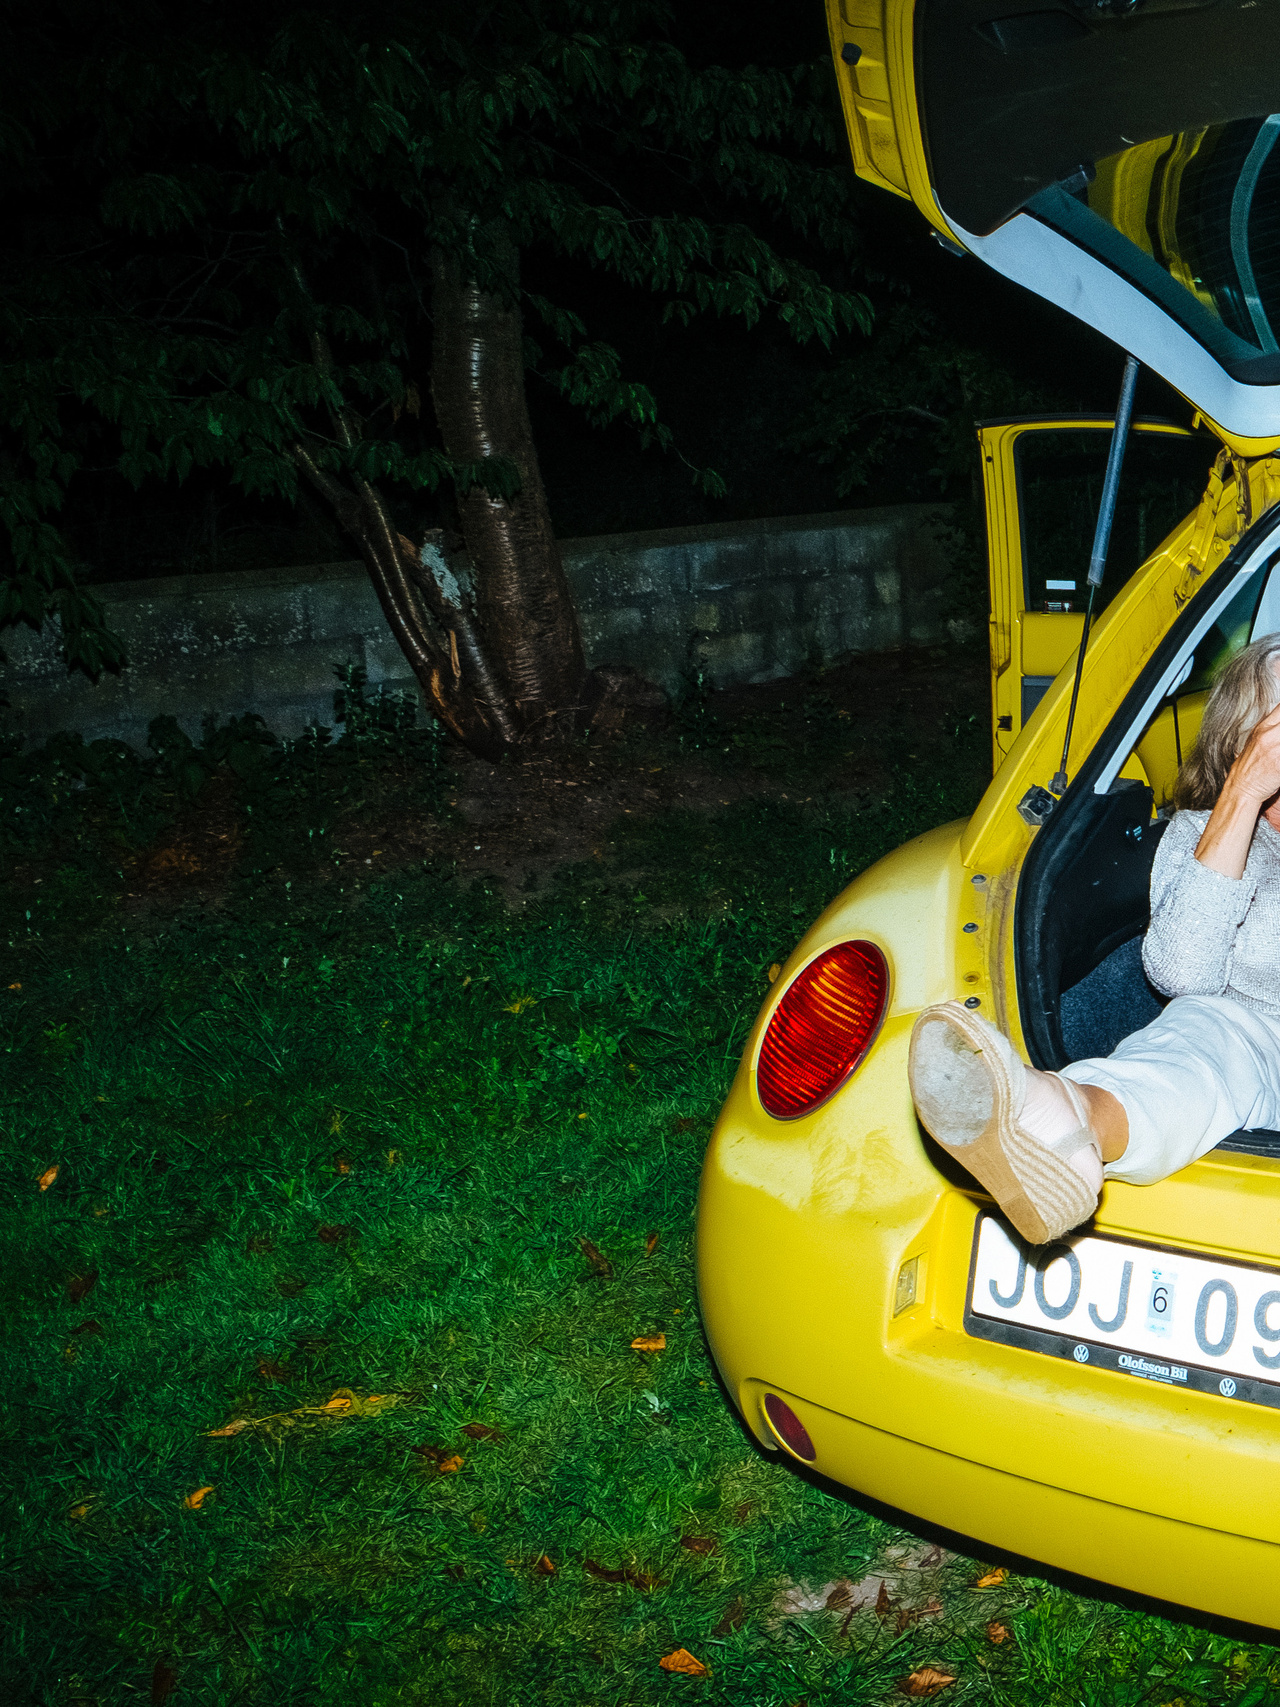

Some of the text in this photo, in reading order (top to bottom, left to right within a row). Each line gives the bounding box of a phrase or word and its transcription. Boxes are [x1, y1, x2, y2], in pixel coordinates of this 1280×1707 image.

[989, 1239, 1133, 1333] JOJ
[1152, 1287, 1169, 1313] 6
[1118, 1354, 1170, 1377] Olofsson
[1170, 1365, 1188, 1381] Bil
